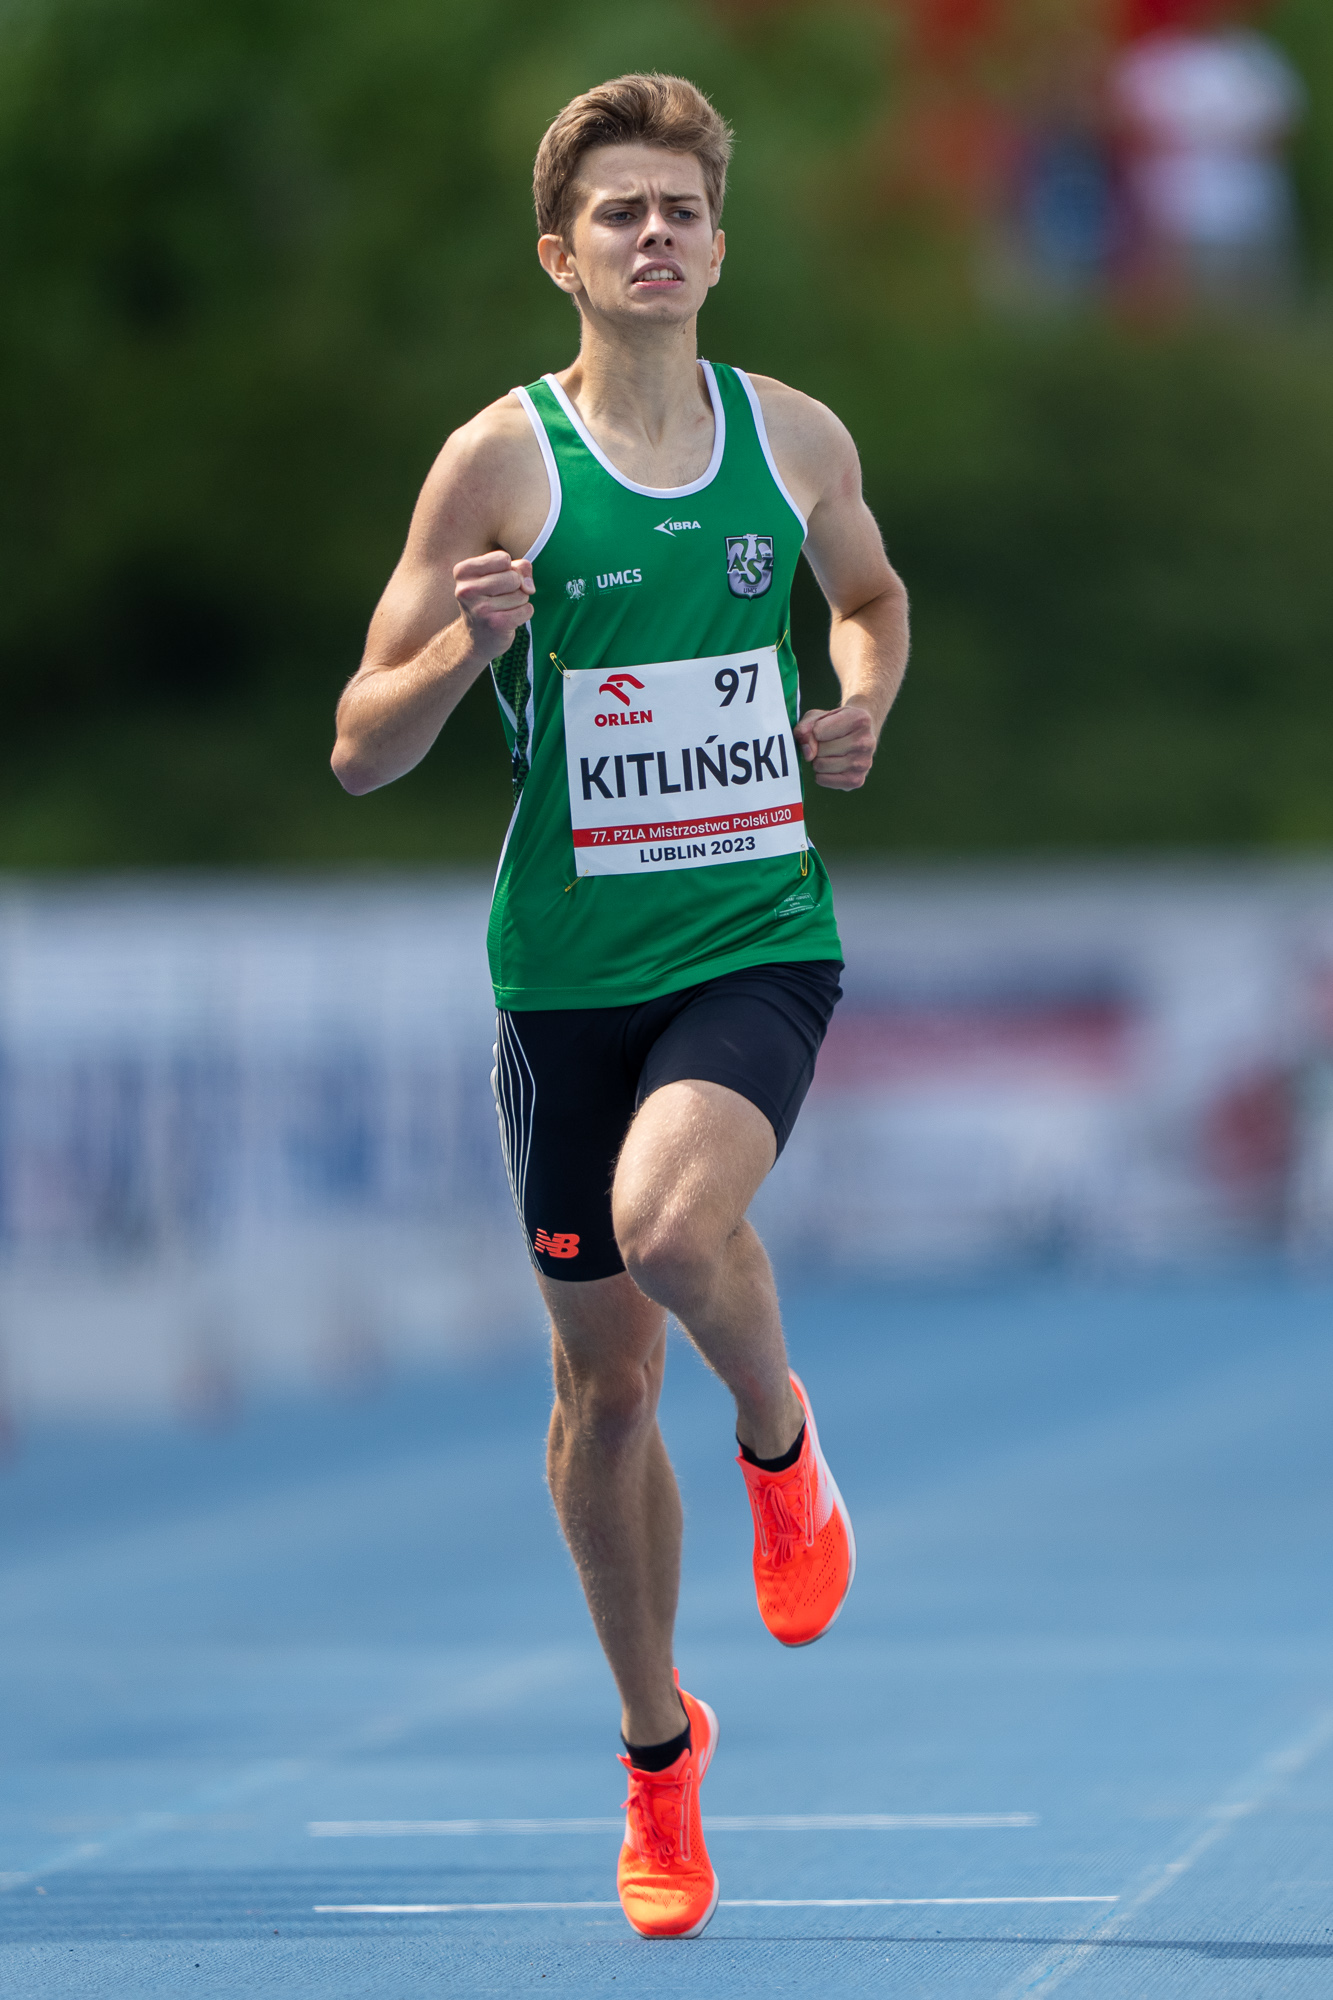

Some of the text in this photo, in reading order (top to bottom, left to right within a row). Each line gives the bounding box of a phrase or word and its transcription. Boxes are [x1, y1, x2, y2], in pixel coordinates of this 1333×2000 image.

[669, 520, 701, 531] IBRA
[596, 568, 642, 589] UMCS
[714, 663, 759, 708] 97
[594, 710, 653, 727] ORLEN
[580, 734, 789, 800] KITLIŃSKI
[591, 808, 792, 843] 77. PZLA Mistrzostwa Polski U20
[640, 836, 756, 863] LUBLIN 2023
